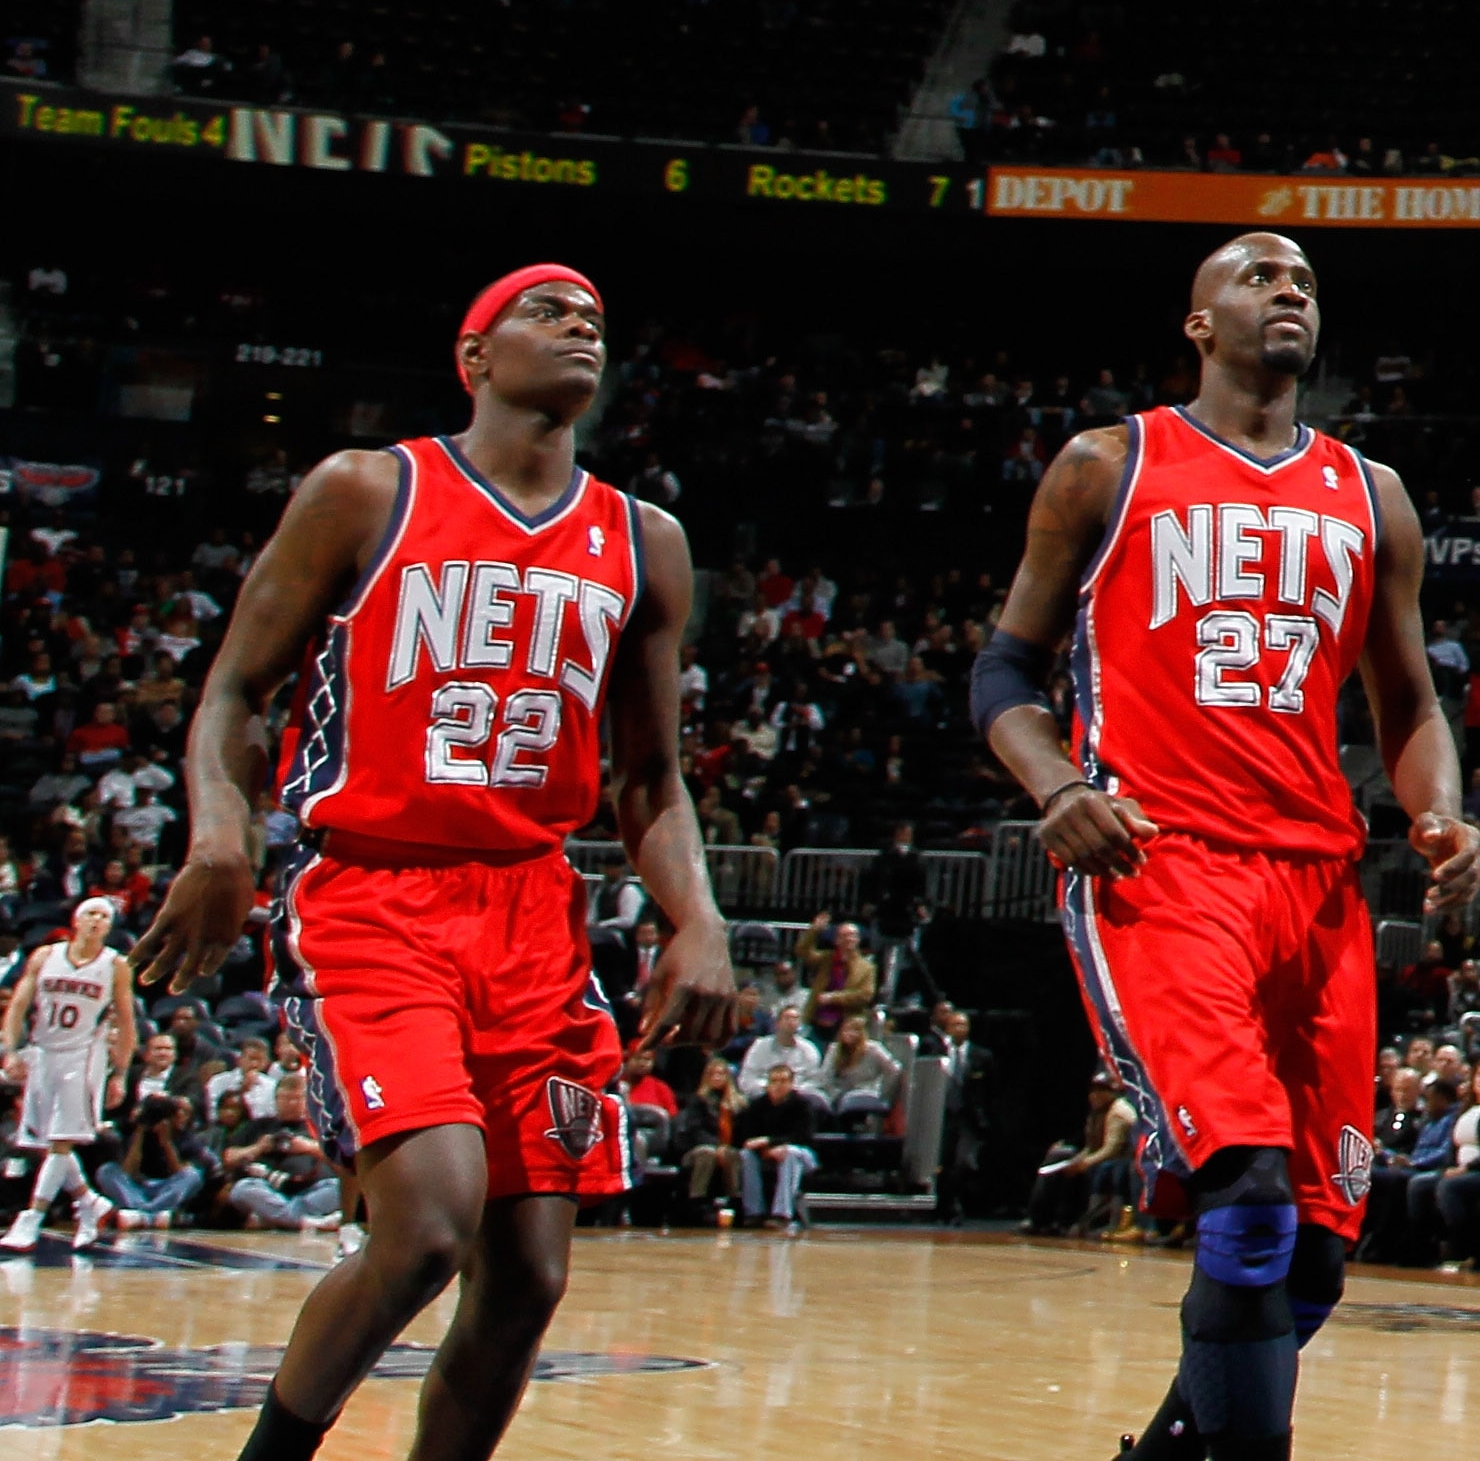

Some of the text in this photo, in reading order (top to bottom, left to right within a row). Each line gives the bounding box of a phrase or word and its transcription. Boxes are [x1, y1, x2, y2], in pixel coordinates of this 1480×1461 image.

[16, 93, 105, 137] Team
[110, 105, 199, 147] Fouls
[201, 115, 227, 147] 4
[464, 142, 689, 193] Pistons 6
[746, 163, 887, 207] Rockets
[927, 175, 951, 209] 7
[992, 174, 1134, 214] DEPOT
[1298, 185, 1385, 220] THE
[145, 475, 188, 498] 121
[1149, 502, 1366, 644] NETS
[385, 559, 626, 719] NETS
[1194, 610, 1320, 714] 27
[424, 681, 563, 789] 22
[49, 1002, 80, 1029] 10
